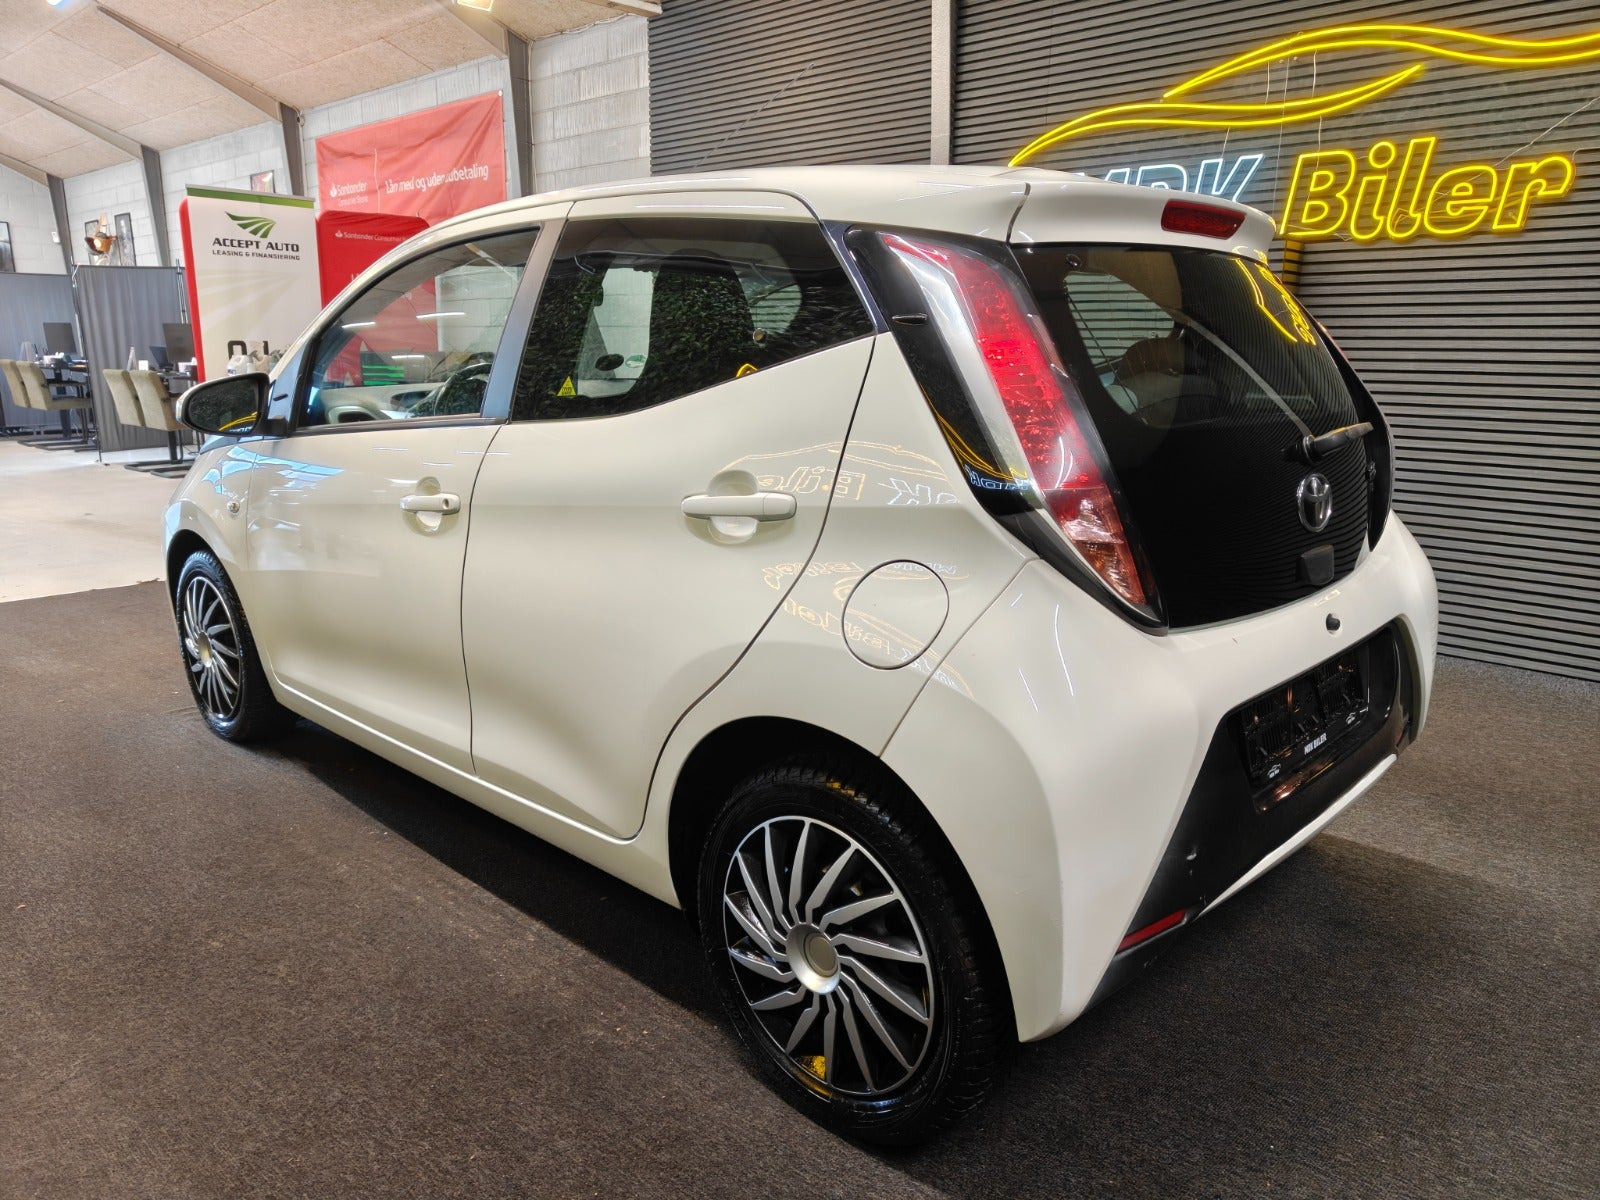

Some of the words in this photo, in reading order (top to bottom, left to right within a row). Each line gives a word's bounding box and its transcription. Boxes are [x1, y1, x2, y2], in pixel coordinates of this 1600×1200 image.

[415, 177, 427, 192] og
[1279, 137, 1574, 240] Biler
[343, 231, 373, 240] Santander
[212, 237, 260, 250] ACCEPT
[265, 241, 299, 252] AUTO
[212, 249, 244, 257] LEASING
[251, 252, 300, 261] FINANSIERING
